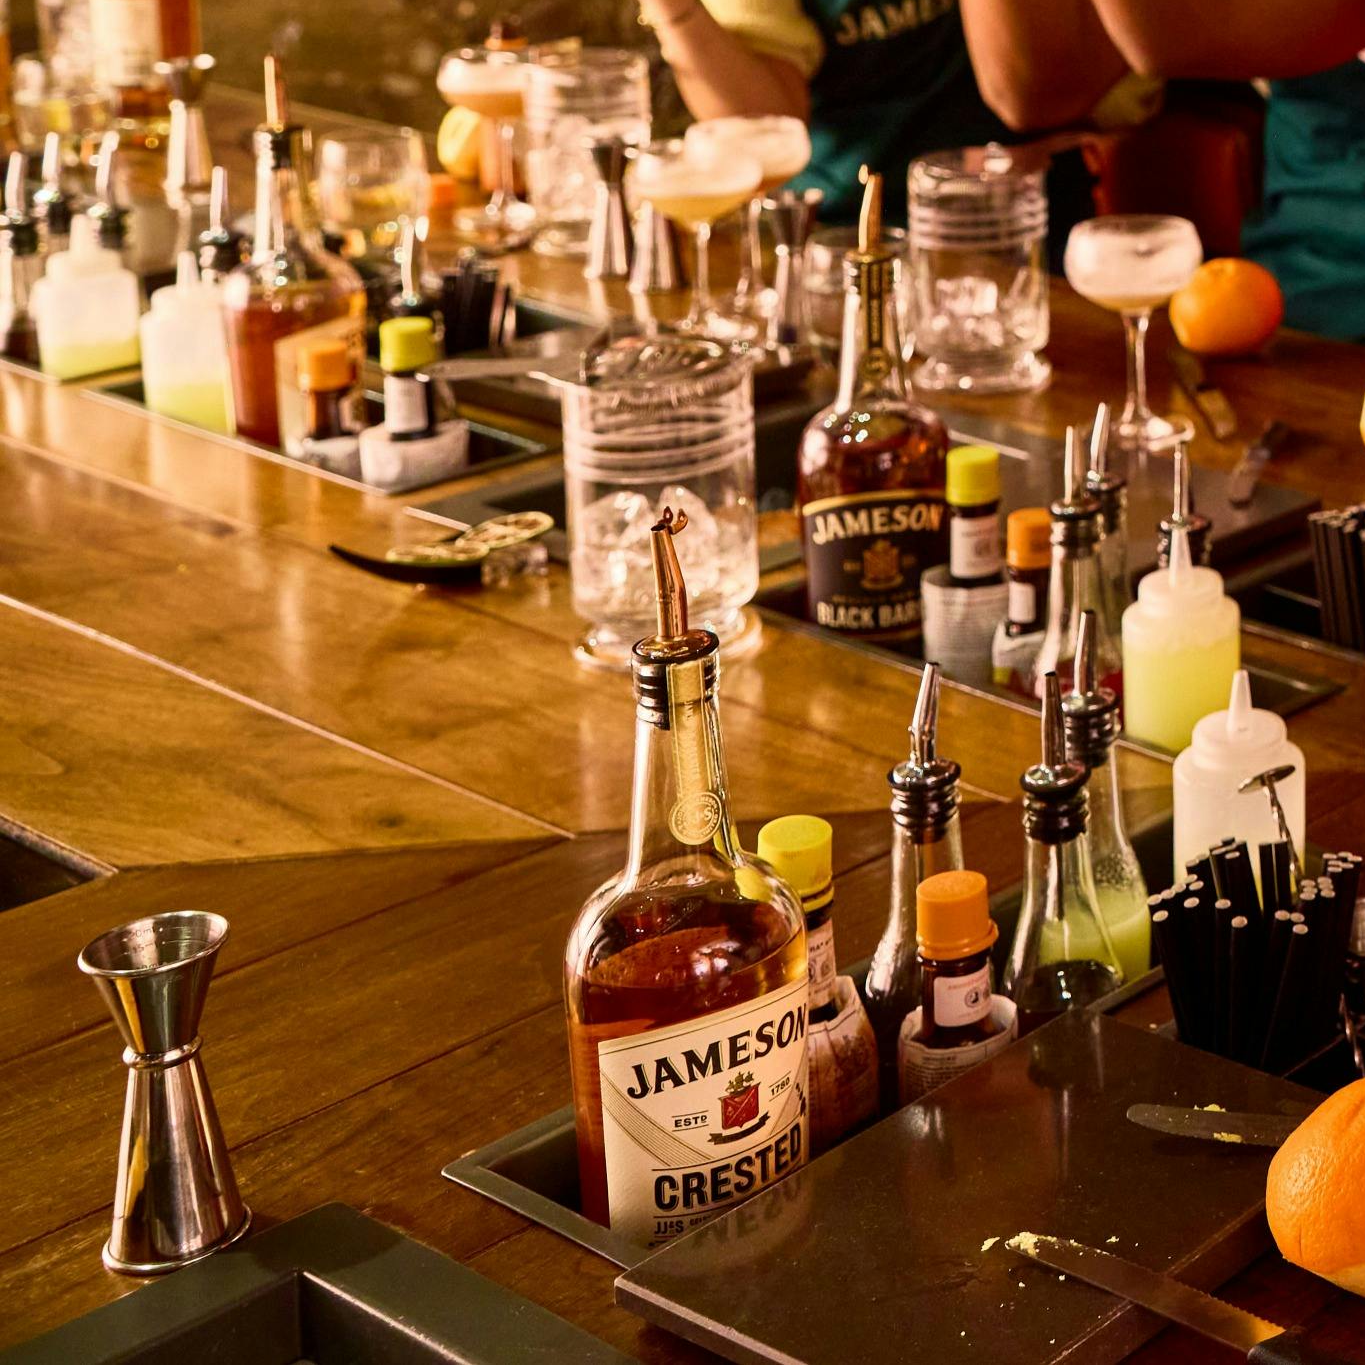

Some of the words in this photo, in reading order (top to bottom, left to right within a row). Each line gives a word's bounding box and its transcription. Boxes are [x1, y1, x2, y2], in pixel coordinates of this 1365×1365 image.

[812, 503, 944, 546] JAMESON
[816, 601, 875, 629] BLACK
[626, 1003, 808, 1100] JAMESON
[770, 1076, 791, 1096] 1780
[653, 1122, 803, 1211] CRESTED
